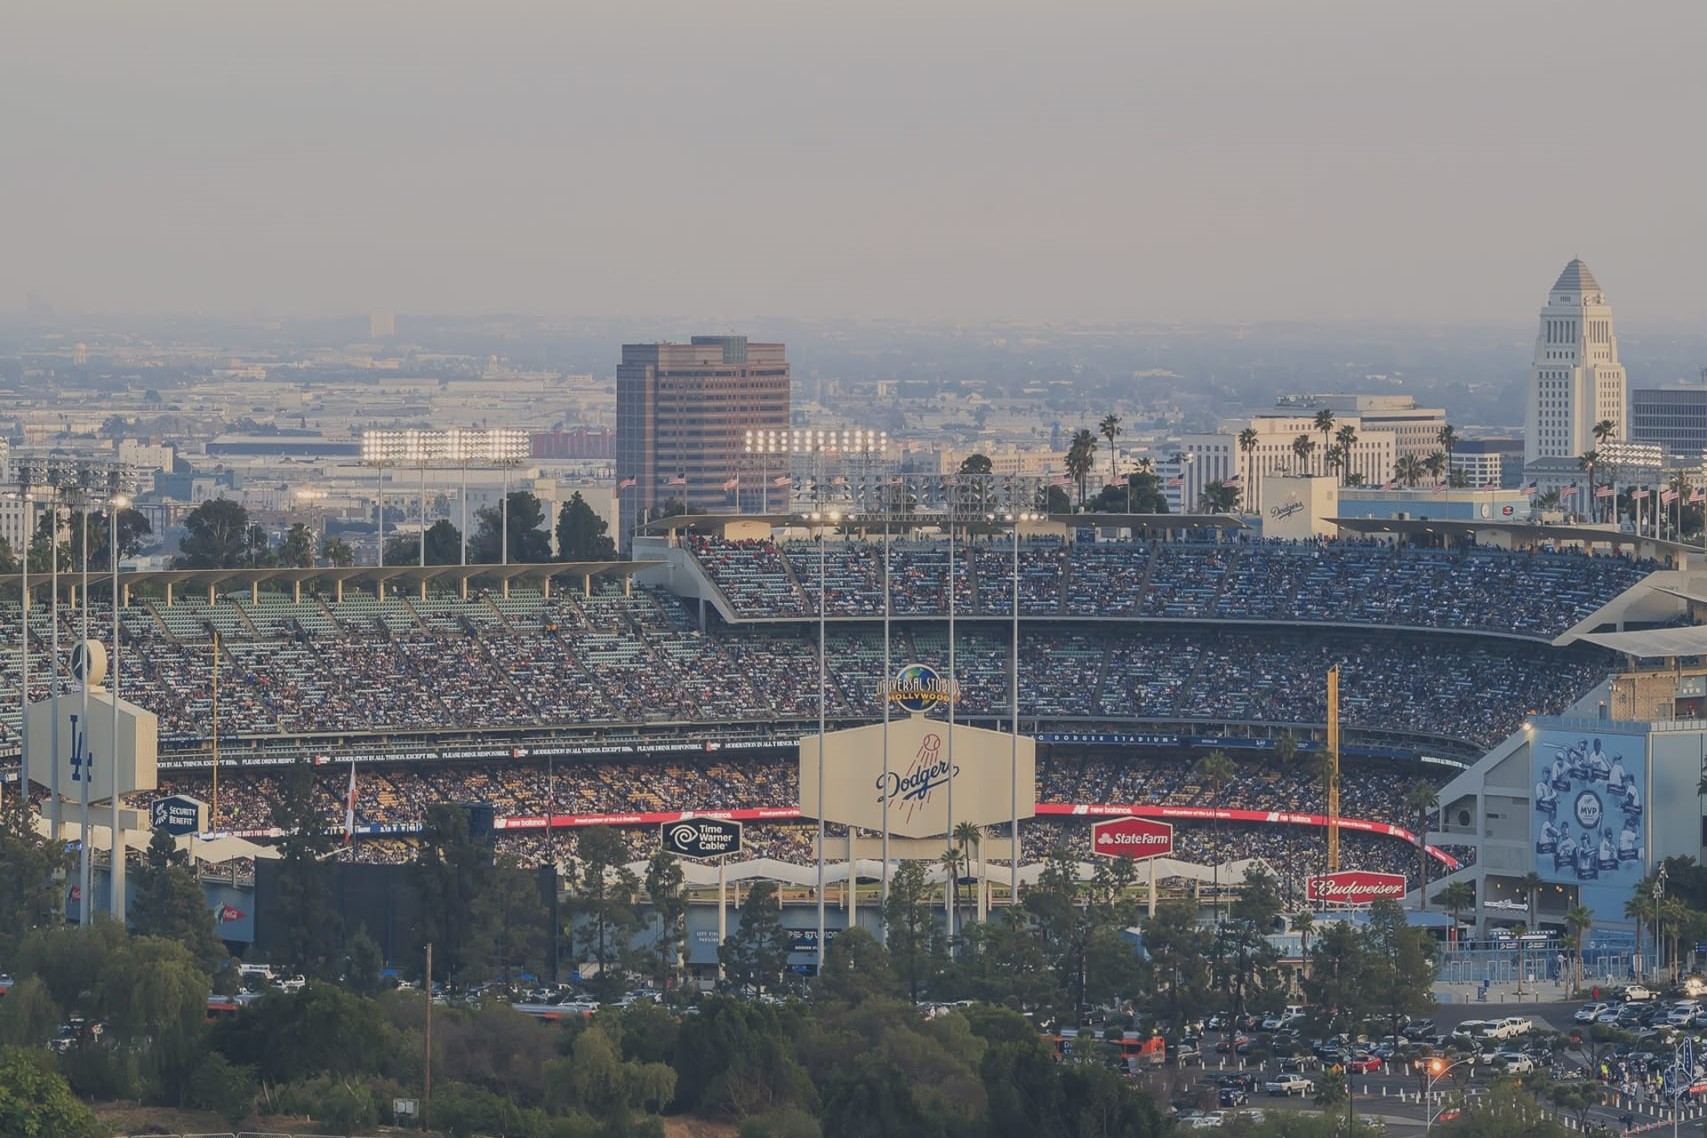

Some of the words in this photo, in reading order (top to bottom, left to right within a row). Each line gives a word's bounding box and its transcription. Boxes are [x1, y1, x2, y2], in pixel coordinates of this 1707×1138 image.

[1270, 501, 1304, 519] Dodgers
[888, 693, 950, 702] HOLLYWOOD
[876, 760, 959, 802] Dodger
[169, 805, 196, 816] SECURITY
[1580, 806, 1597, 815] MVP
[169, 815, 192, 826] BENEFIT
[699, 825, 722, 834] Time
[700, 834, 733, 842] Warner
[699, 842, 725, 850] Cable
[1311, 880, 1402, 896] Budweiser
[804, 930, 838, 938] STUIO
